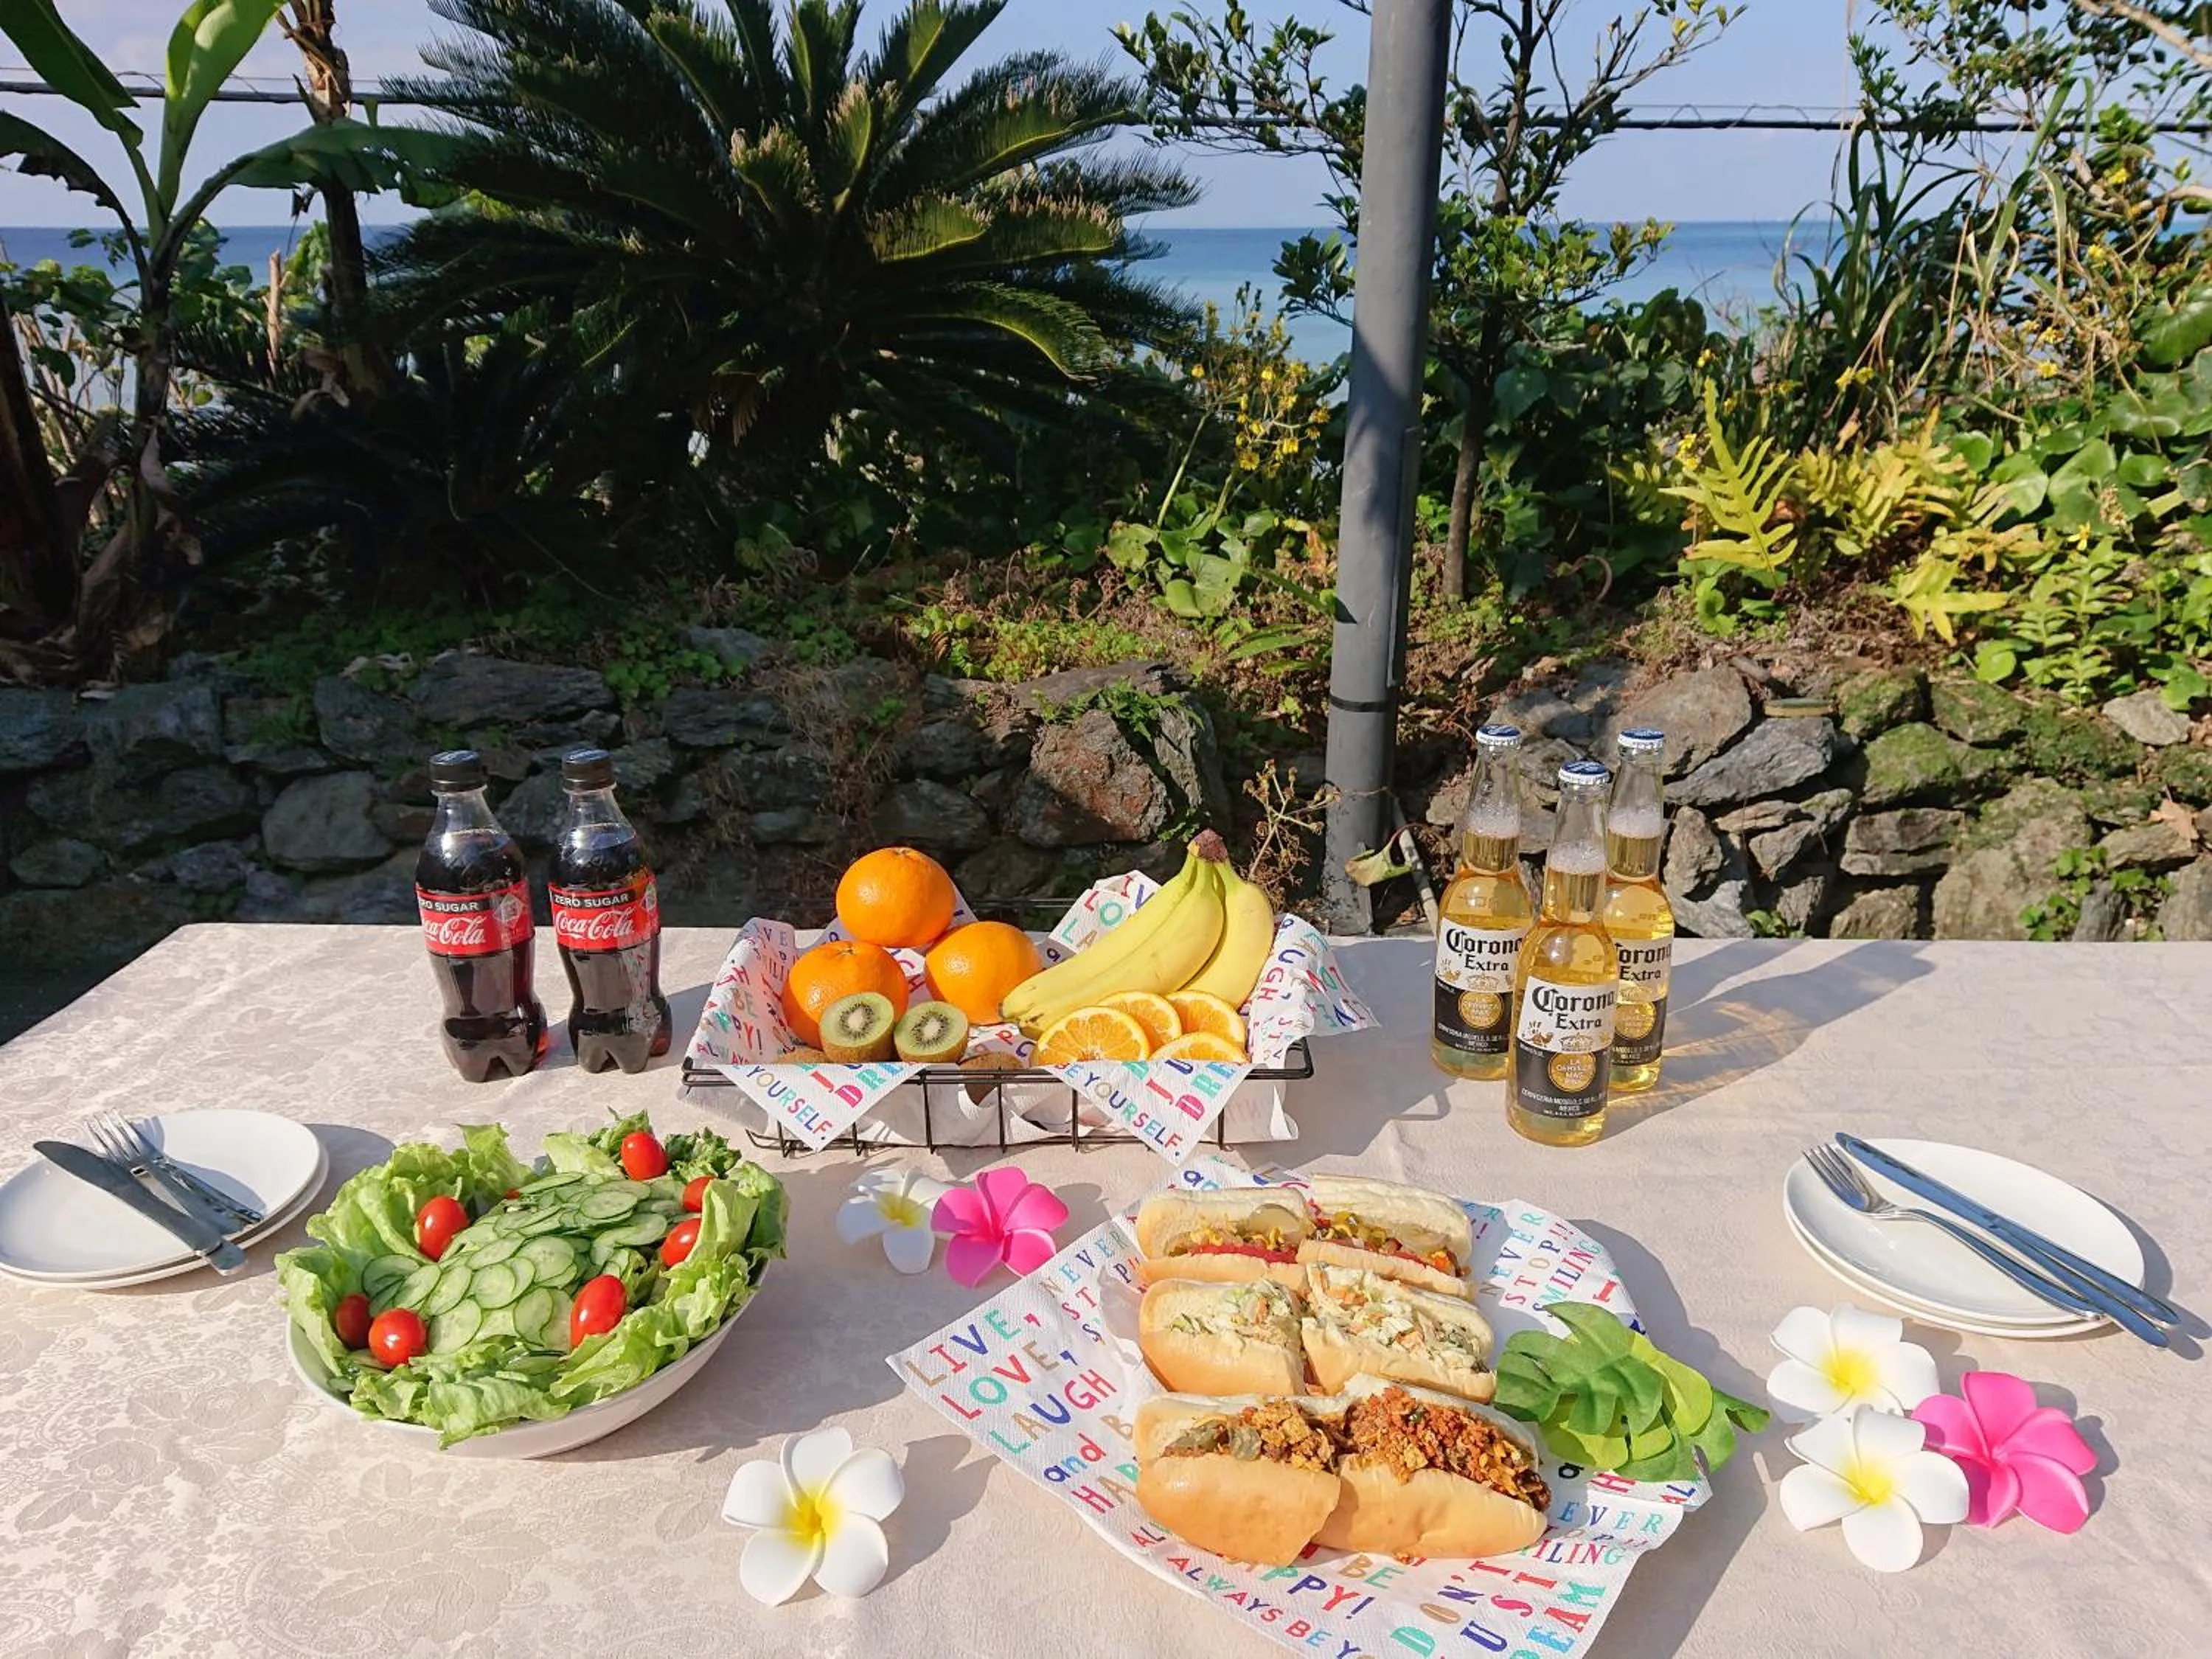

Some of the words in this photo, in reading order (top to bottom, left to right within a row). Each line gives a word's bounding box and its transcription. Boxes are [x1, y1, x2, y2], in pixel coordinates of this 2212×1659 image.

[435, 902, 479, 912] SUGAR
[554, 894, 580, 906] ZERO
[585, 893, 628, 908] SUGAR
[1464, 953, 1509, 971] Extra
[1618, 965, 1662, 981] Extra
[1532, 986, 1615, 1016] Corona
[1555, 1012, 1602, 1030] Extra
[746, 1065, 833, 1141] YOURSELF.
[1083, 1071, 1183, 1157] YOURSELF.
[1175, 1062, 1237, 1121] DRE
[1039, 1230, 1130, 1298] NEVER
[905, 1309, 1042, 1388] LIVE,
[941, 1340, 1079, 1420] LOVE,
[990, 1369, 1119, 1455] LAUGH
[1043, 1433, 1107, 1484] and
[1557, 1500, 1664, 1534] EVER
[1338, 1554, 1405, 1589] BE
[1533, 1539, 1627, 1565] ILING
[1167, 1556, 1284, 1621] ALWAYS
[1285, 1619, 1332, 1648] BE
[1391, 1559, 1512, 1658] DON'T
[1459, 1572, 1558, 1653] UST
